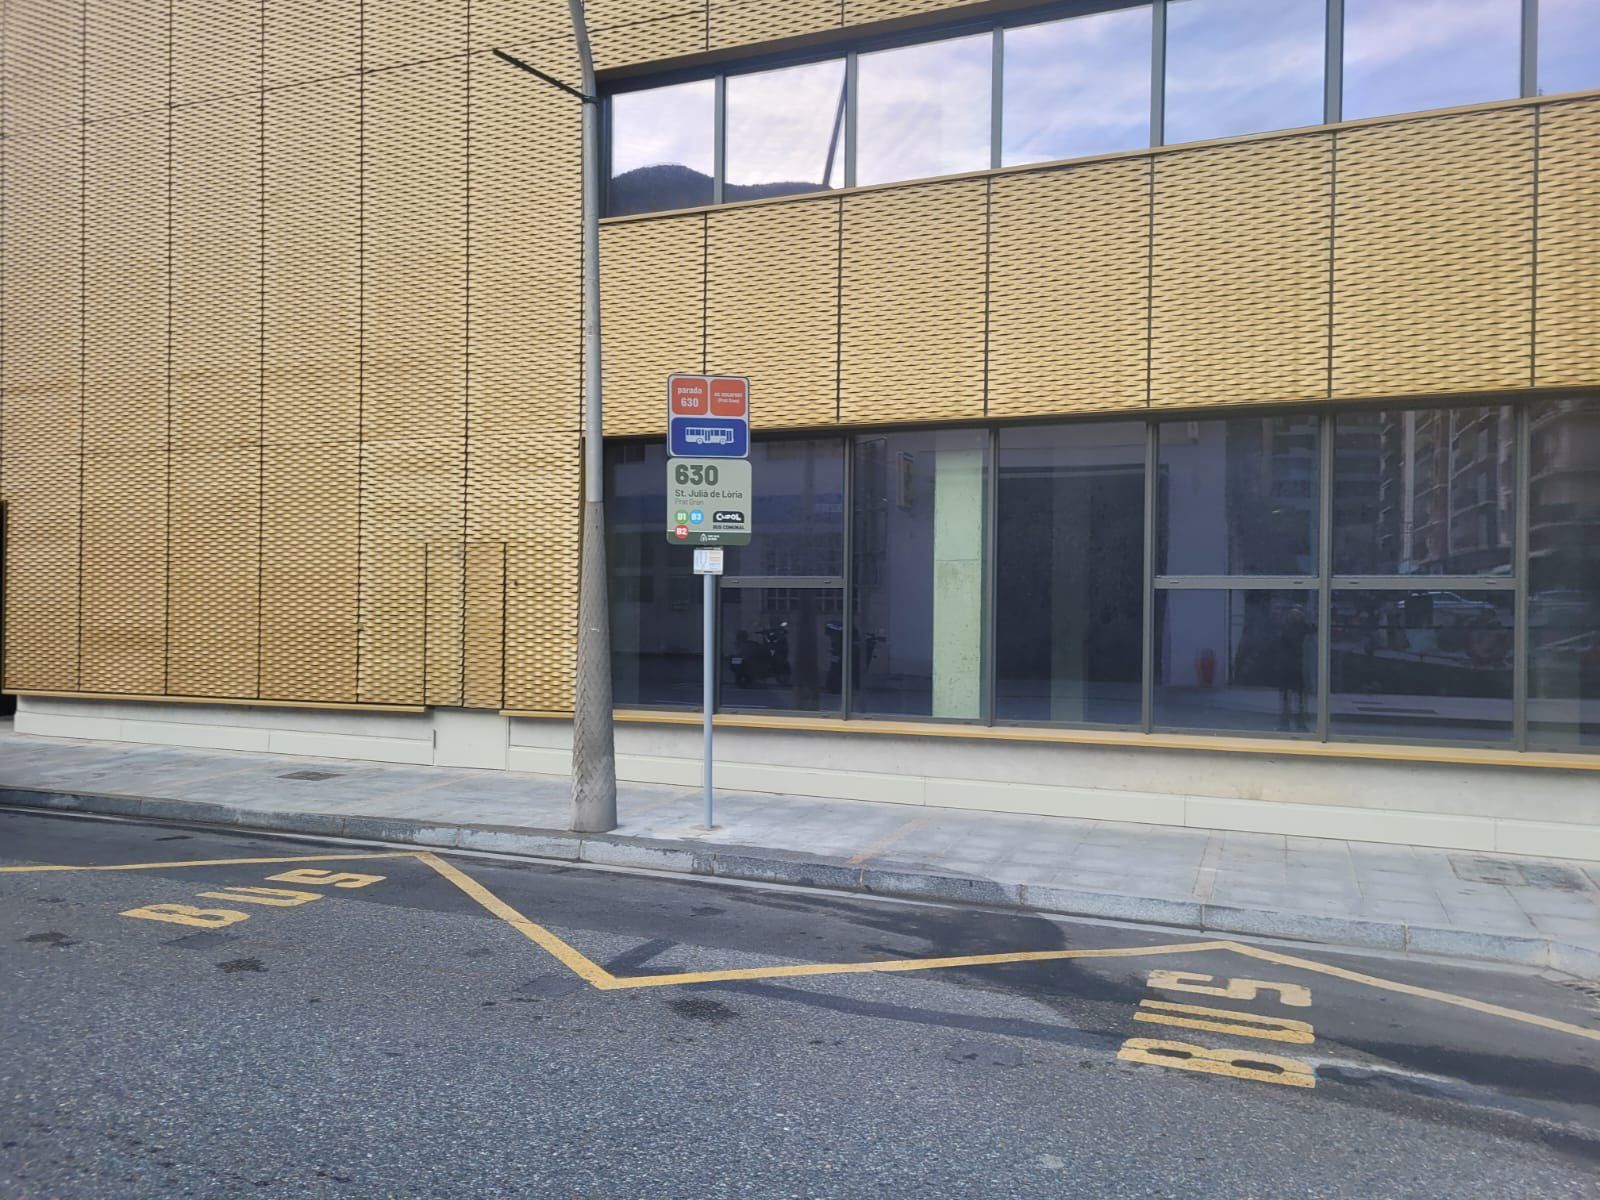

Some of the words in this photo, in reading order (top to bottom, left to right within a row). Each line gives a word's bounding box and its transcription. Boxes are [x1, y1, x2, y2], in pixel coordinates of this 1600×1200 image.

[677, 387, 702, 395] parada
[681, 397, 699, 407] 630
[675, 464, 718, 485] 630
[675, 489, 686, 497] St.
[710, 490, 721, 498] de
[118, 868, 387, 929] BUS
[1116, 969, 1316, 1089] BUS
